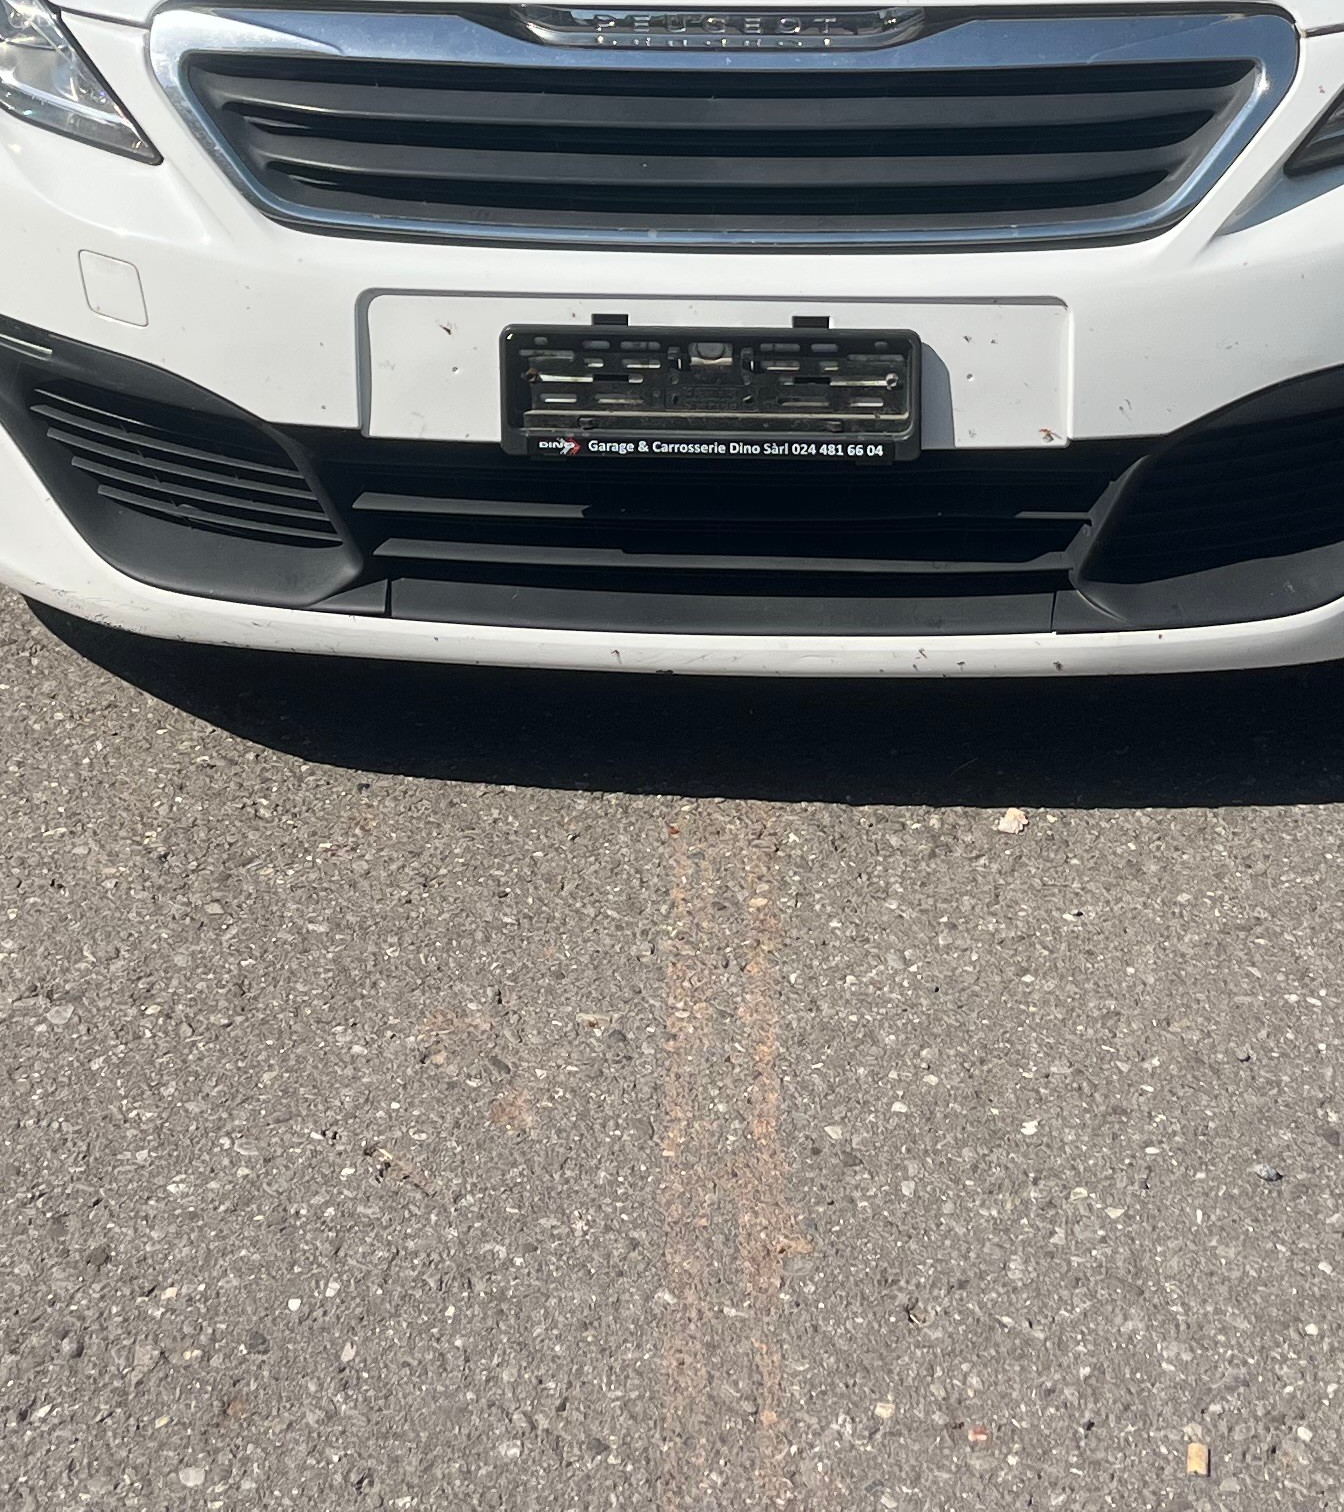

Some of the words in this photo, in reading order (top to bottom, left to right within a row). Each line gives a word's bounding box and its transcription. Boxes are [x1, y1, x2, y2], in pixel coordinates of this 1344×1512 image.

[587, 440, 635, 455] Garage
[637, 440, 649, 453] &
[652, 441, 726, 454] Carrosserie
[729, 442, 761, 455] Dino
[791, 443, 817, 456] 024
[819, 443, 844, 457] 481
[847, 444, 864, 457] 66
[866, 444, 884, 457] 04
